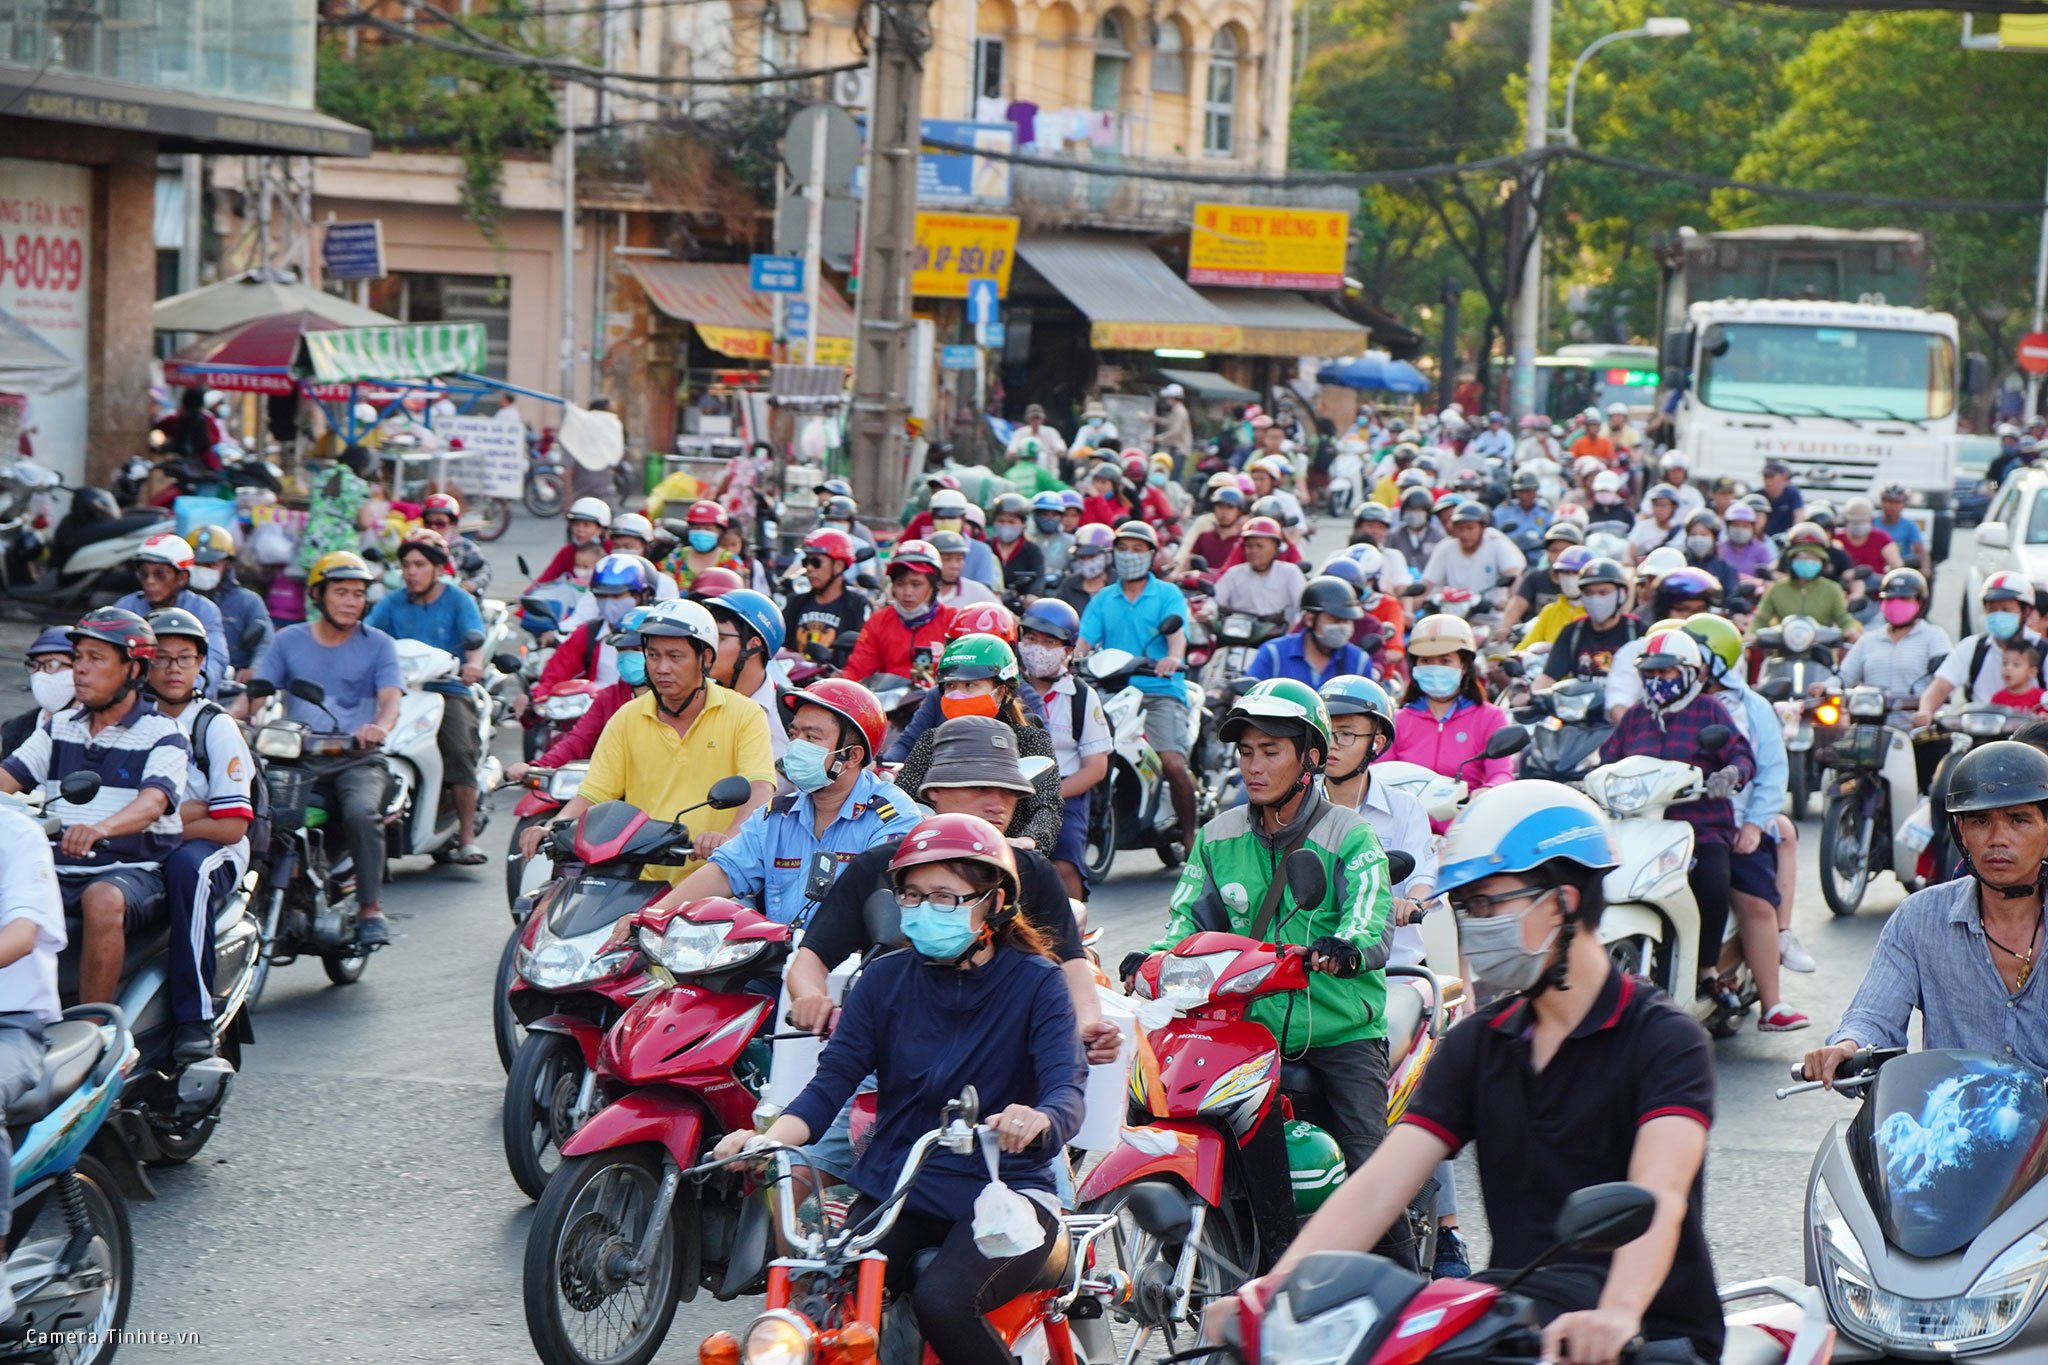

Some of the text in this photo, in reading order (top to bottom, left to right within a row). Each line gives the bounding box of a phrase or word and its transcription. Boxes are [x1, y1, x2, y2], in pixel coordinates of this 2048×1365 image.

[206, 372, 292, 392] LOTTERIA
[1754, 438, 1892, 457] HYUNDAI
[1178, 1032, 1213, 1041] HONDA
[704, 1082, 735, 1093] HONDA
